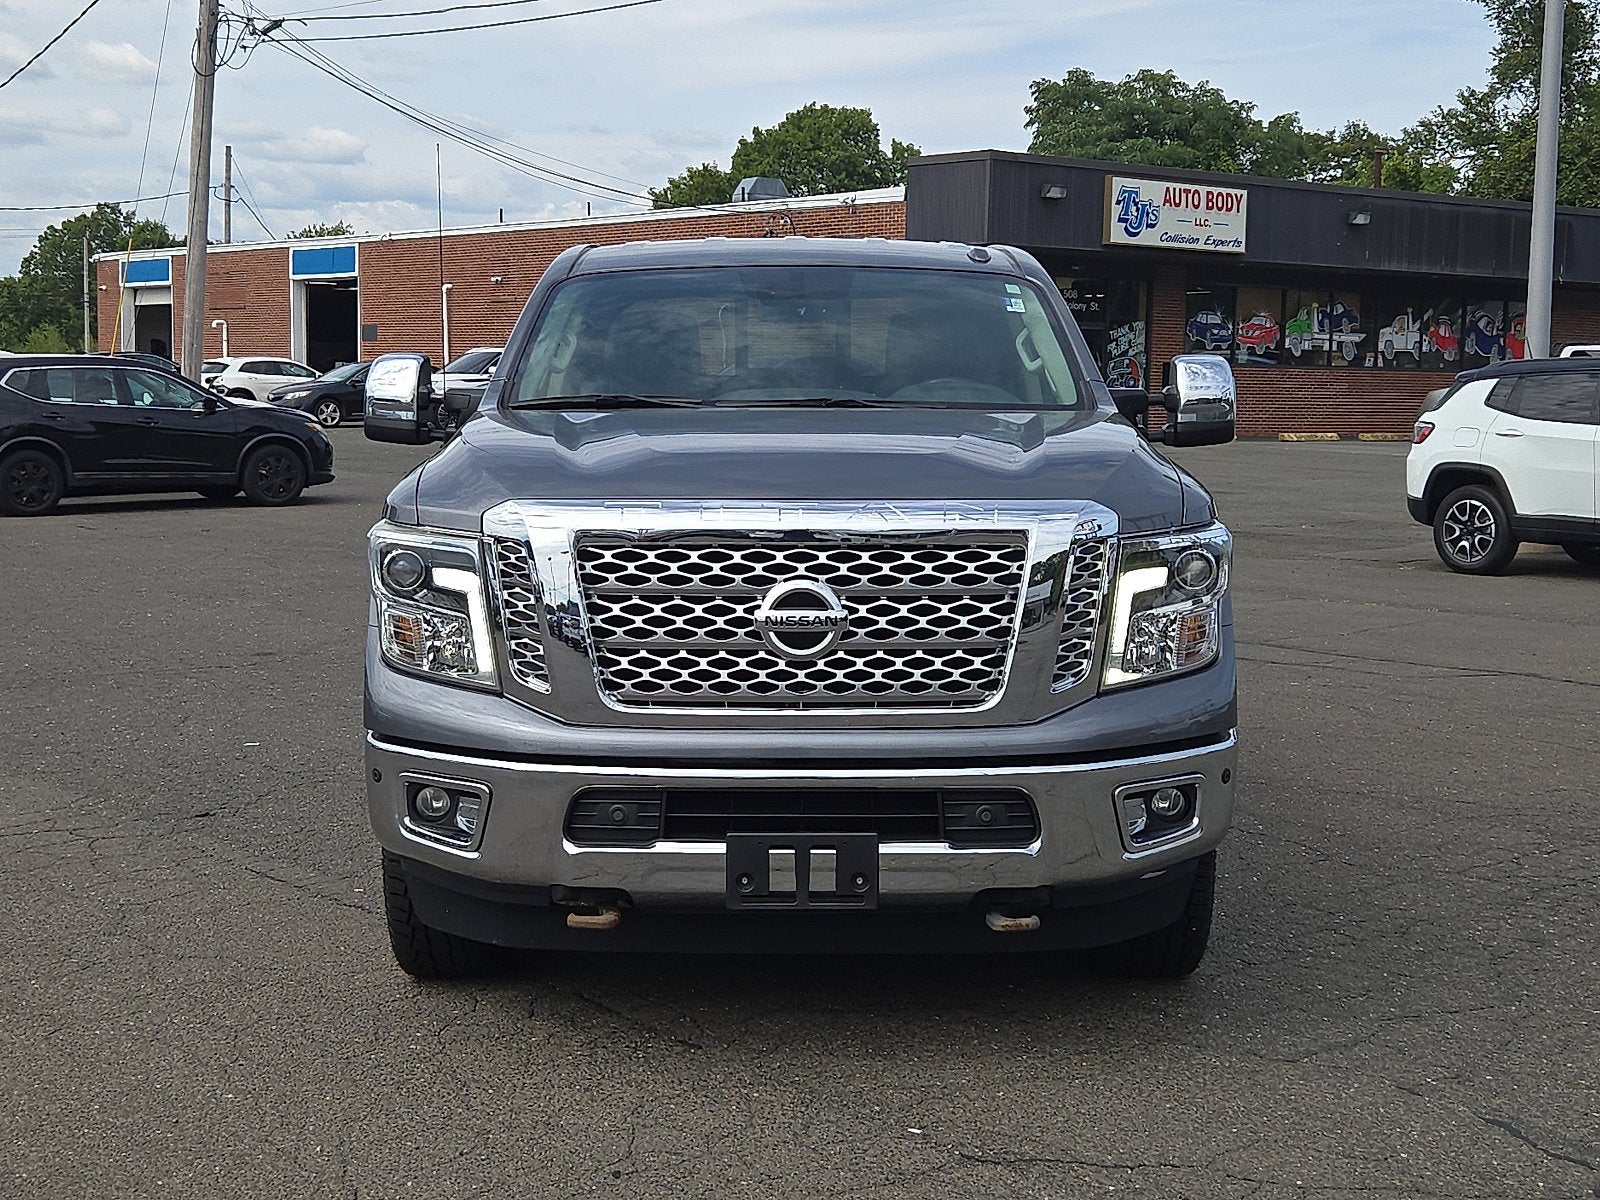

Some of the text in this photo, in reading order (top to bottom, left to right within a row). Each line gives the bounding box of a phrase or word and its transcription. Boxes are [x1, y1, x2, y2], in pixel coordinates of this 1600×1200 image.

[1162, 186, 1244, 213] AUTO BODY
[1194, 218, 1211, 228] LLC.
[1159, 231, 1242, 248] Collision Experts
[1063, 289, 1078, 299] 508
[1067, 301, 1087, 312] olony
[764, 615, 839, 627] NISSAN
